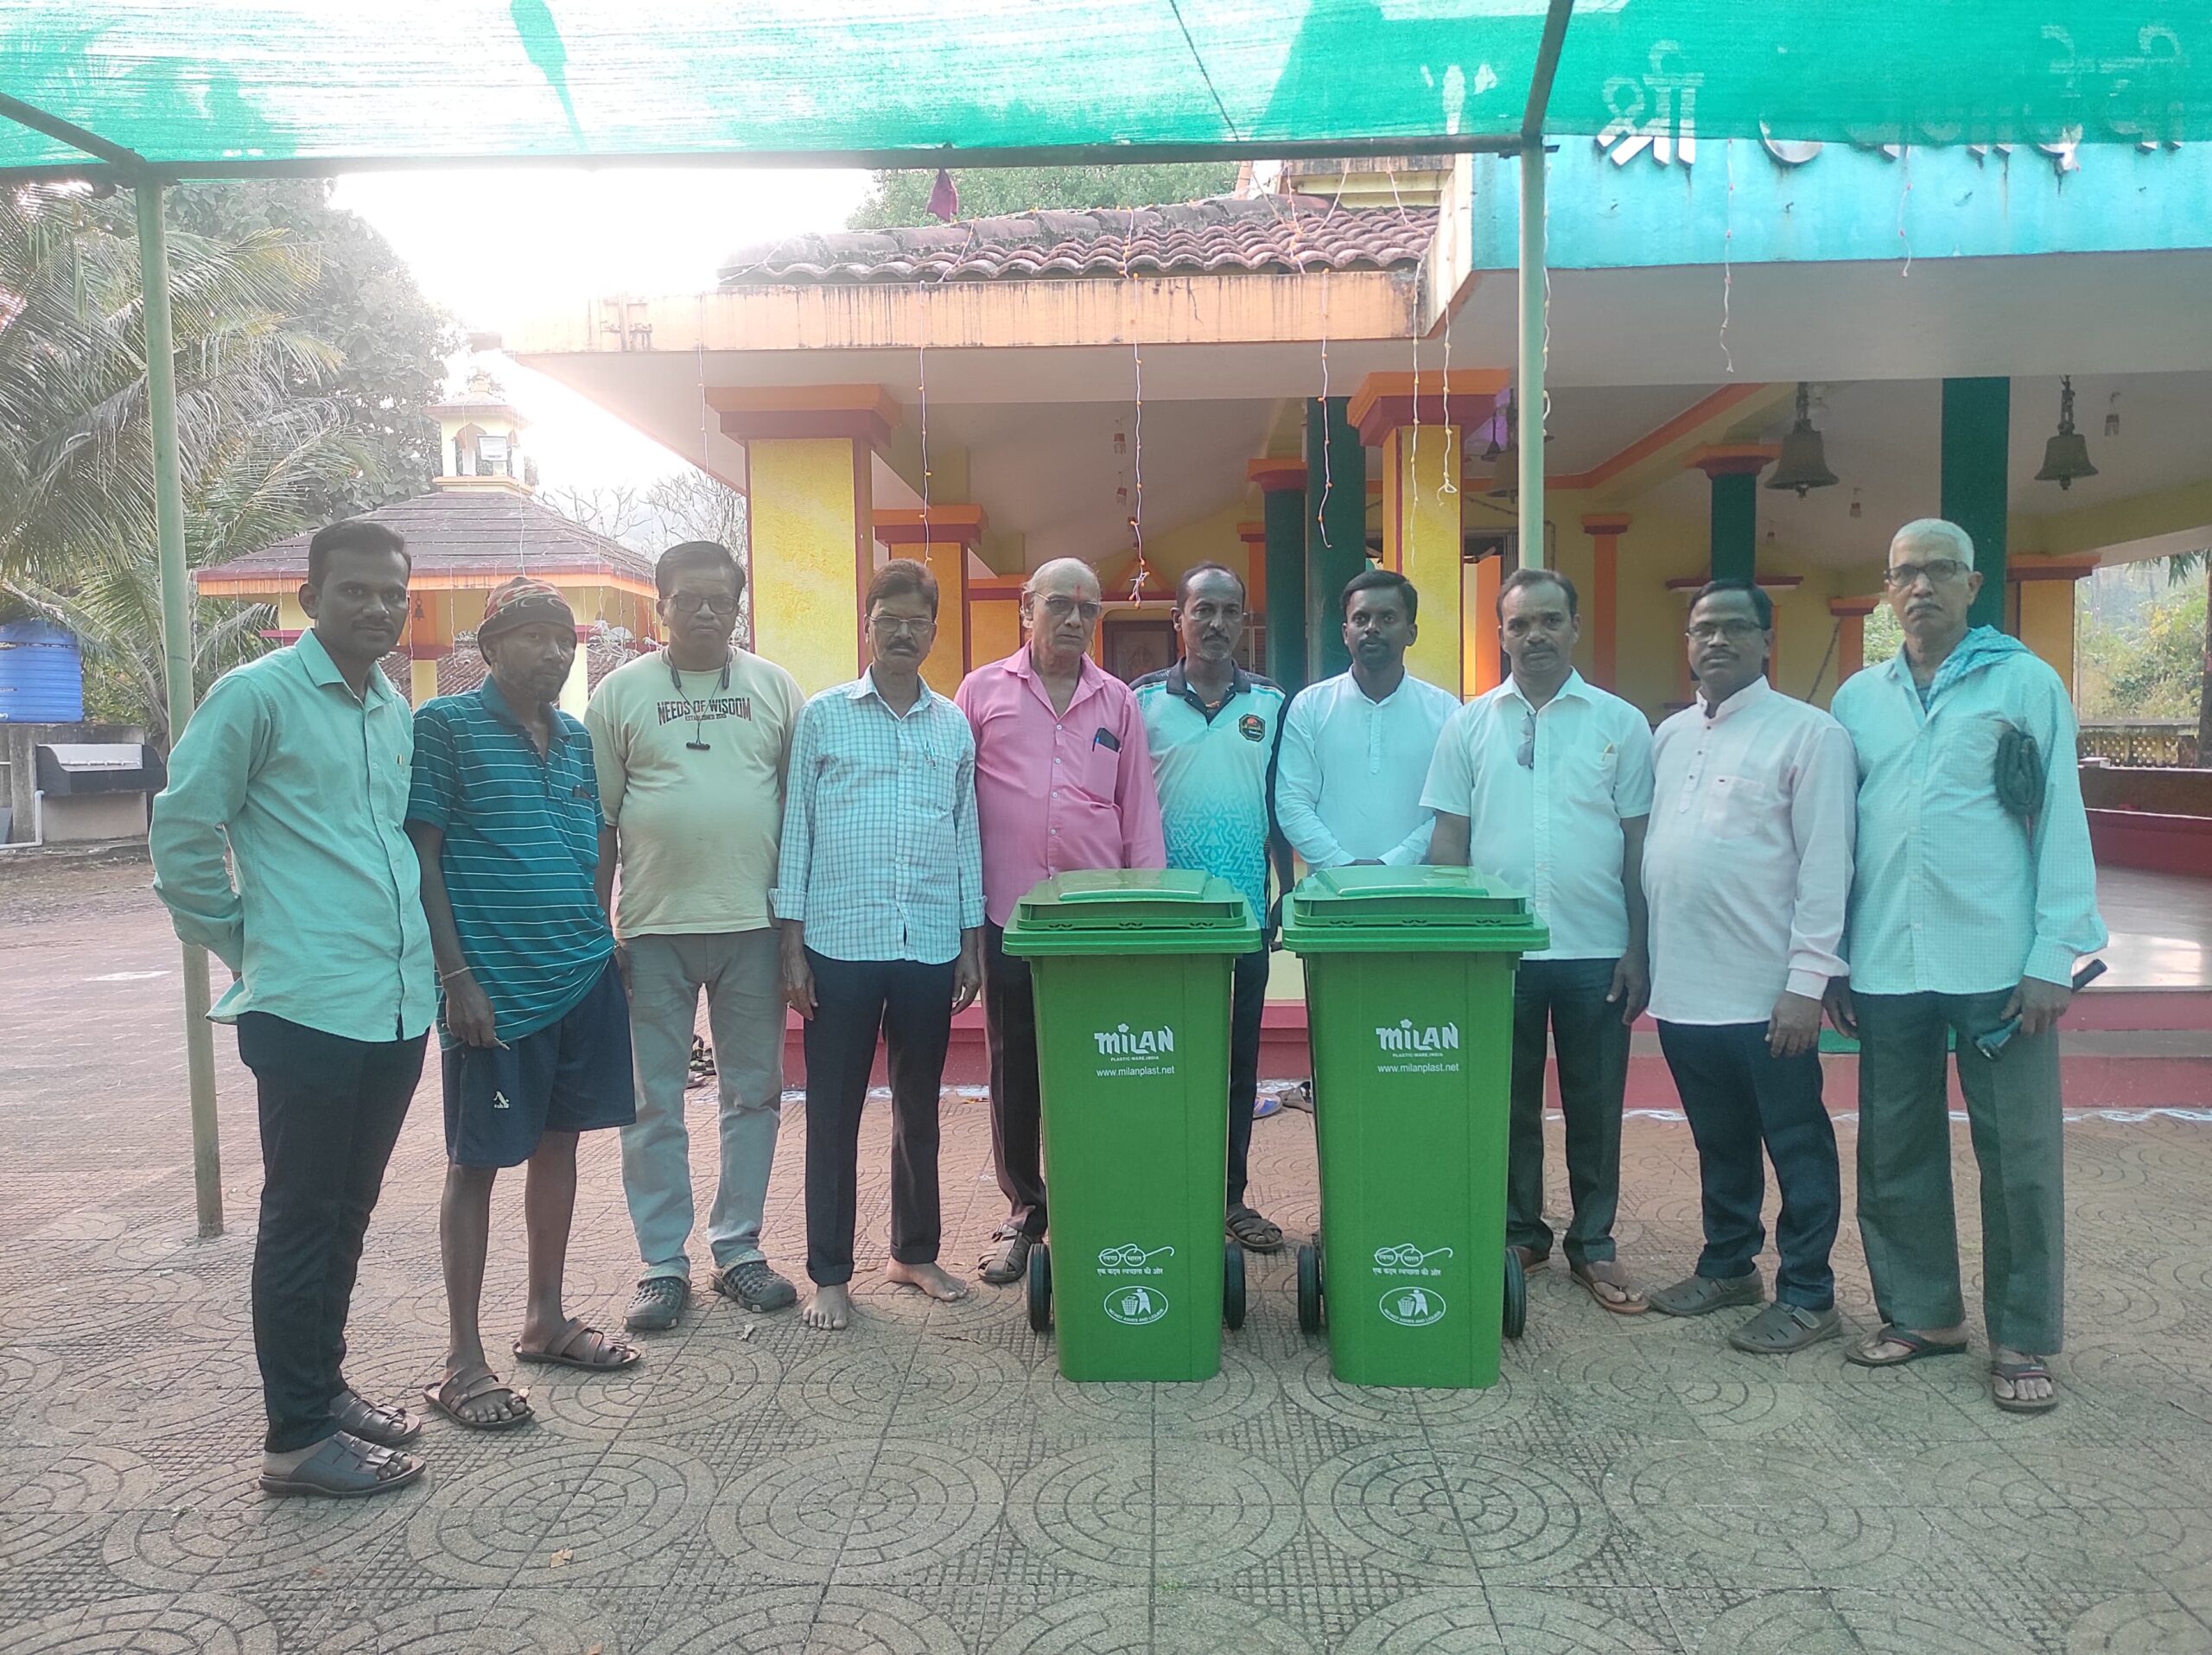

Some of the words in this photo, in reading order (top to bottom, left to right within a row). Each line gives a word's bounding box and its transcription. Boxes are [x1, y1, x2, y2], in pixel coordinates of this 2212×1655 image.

[1596, 39, 1705, 166] श्री
[657, 701, 690, 726] NEEDS
[693, 700, 706, 713] OF
[709, 697, 752, 722] WISDOM
[1096, 1066, 1175, 1078] www.milanplast.net
[1377, 1063, 1459, 1074] www.milanplast.net
